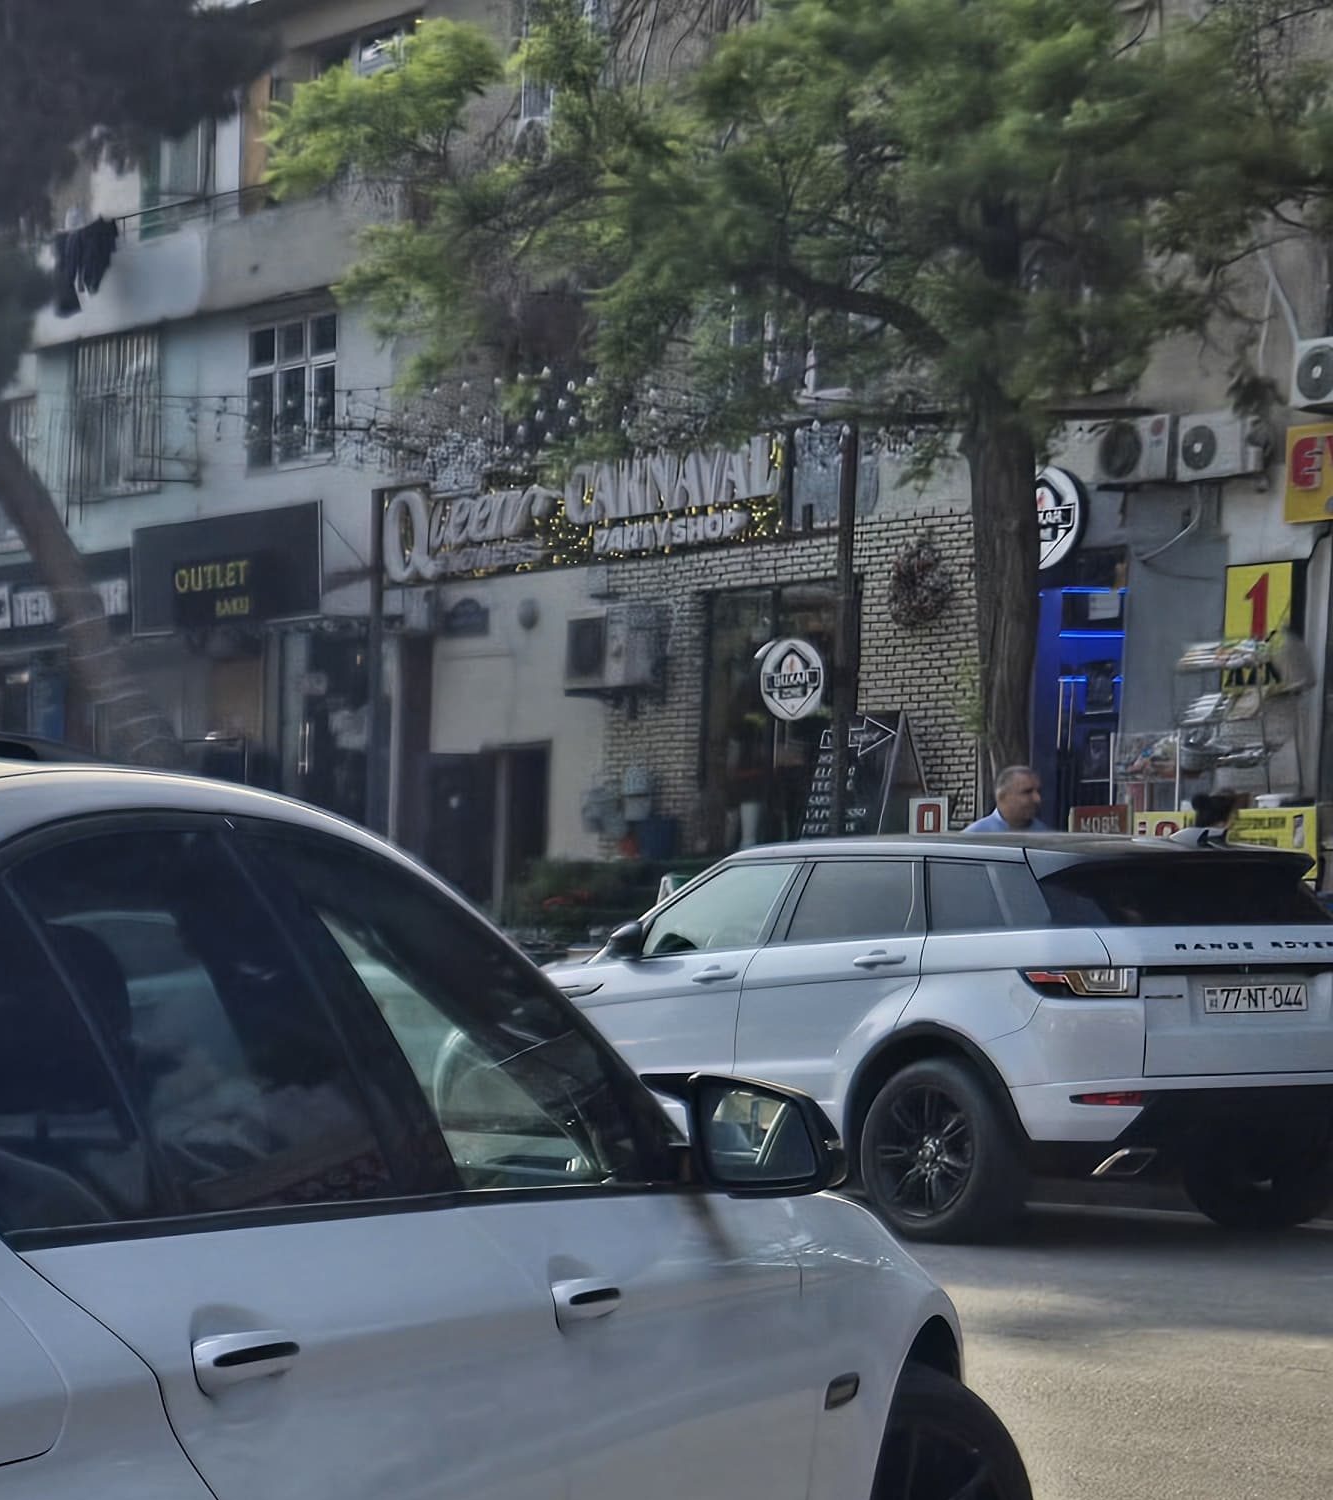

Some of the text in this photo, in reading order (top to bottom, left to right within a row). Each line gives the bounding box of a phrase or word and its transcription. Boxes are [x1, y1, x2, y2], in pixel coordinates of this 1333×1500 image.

[1293, 435, 1333, 490] E
[672, 511, 748, 545] SHOP
[175, 560, 249, 594] OUTLET
[1174, 942, 1254, 950] RANGE
[1220, 986, 1303, 1010] 77-NT-044
